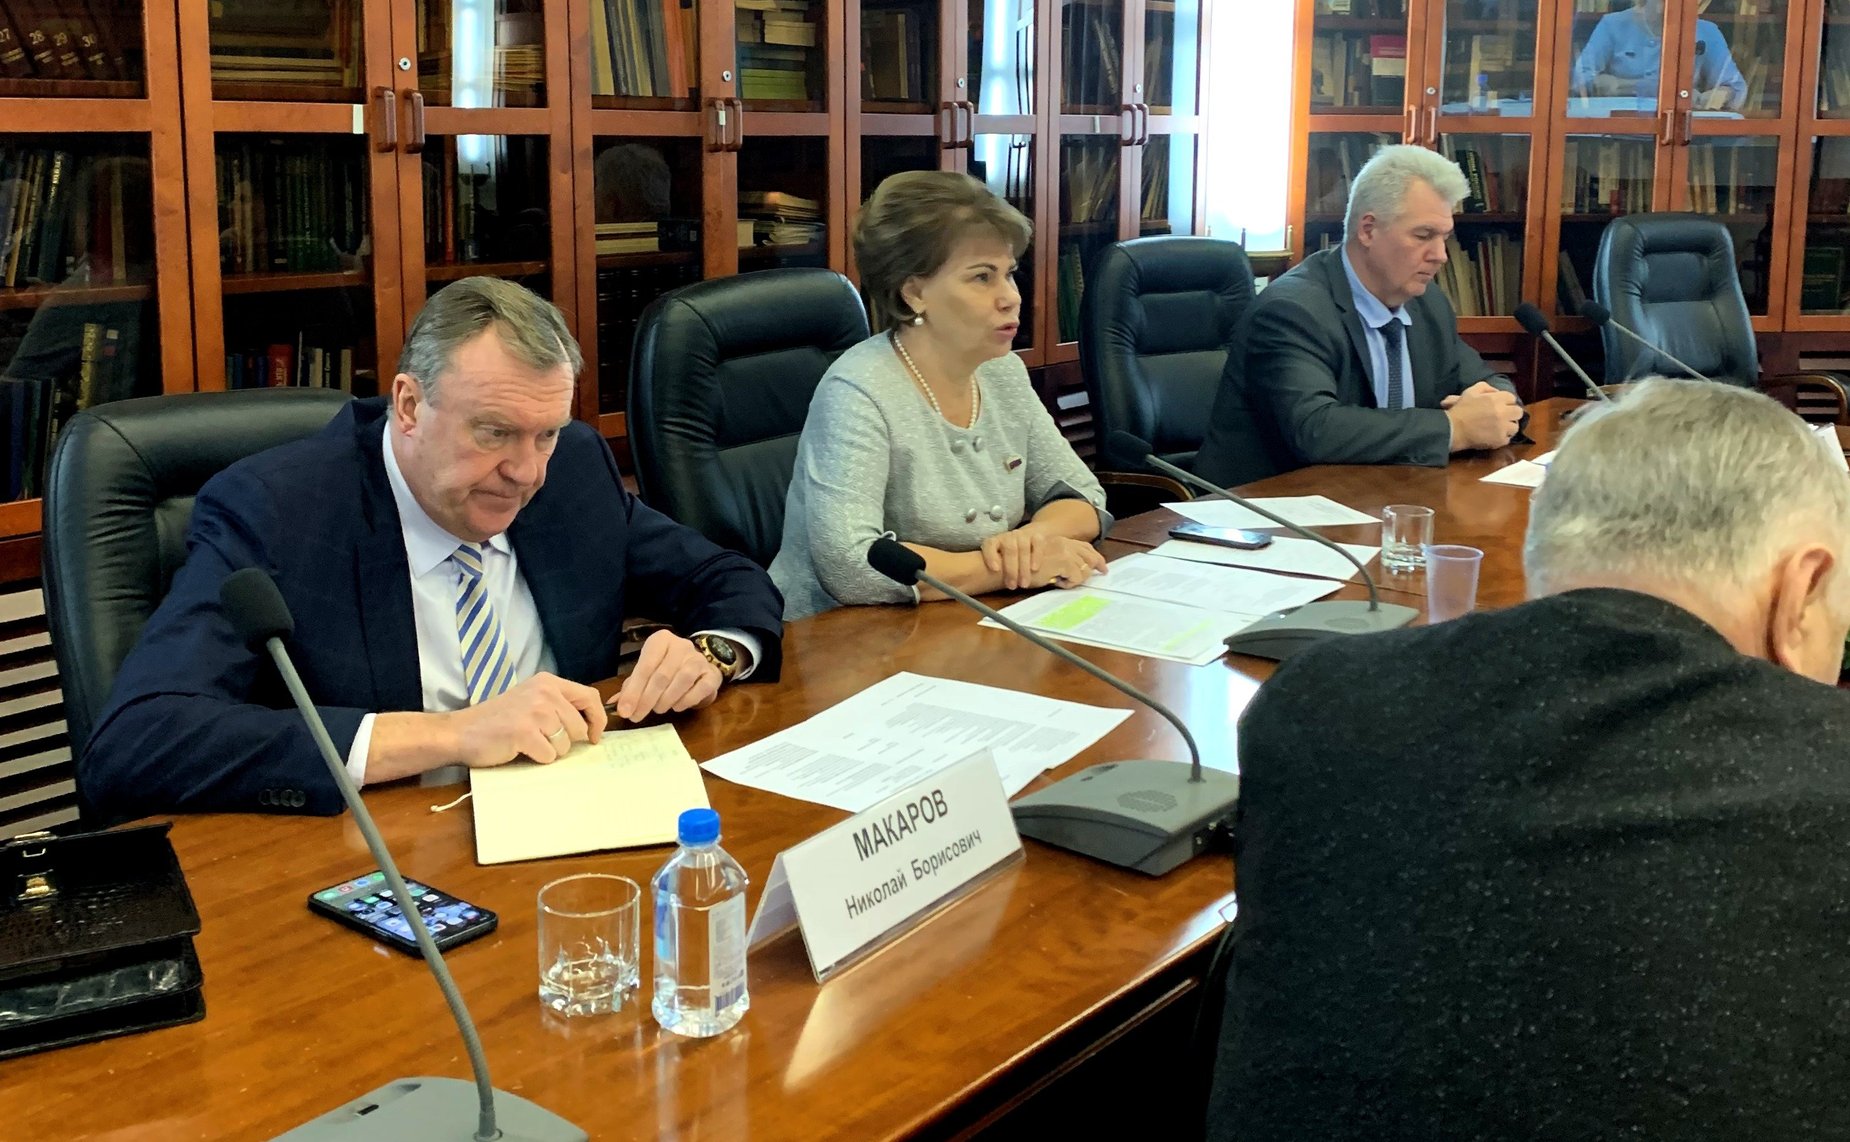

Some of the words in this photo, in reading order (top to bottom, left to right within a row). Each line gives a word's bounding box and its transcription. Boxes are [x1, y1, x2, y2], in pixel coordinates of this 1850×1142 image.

[29, 30, 45, 45] 28
[53, 32, 68, 46] 29
[852, 788, 949, 862] МАКАРОВ
[845, 868, 908, 919] Николай
[911, 829, 983, 881] Борисович
